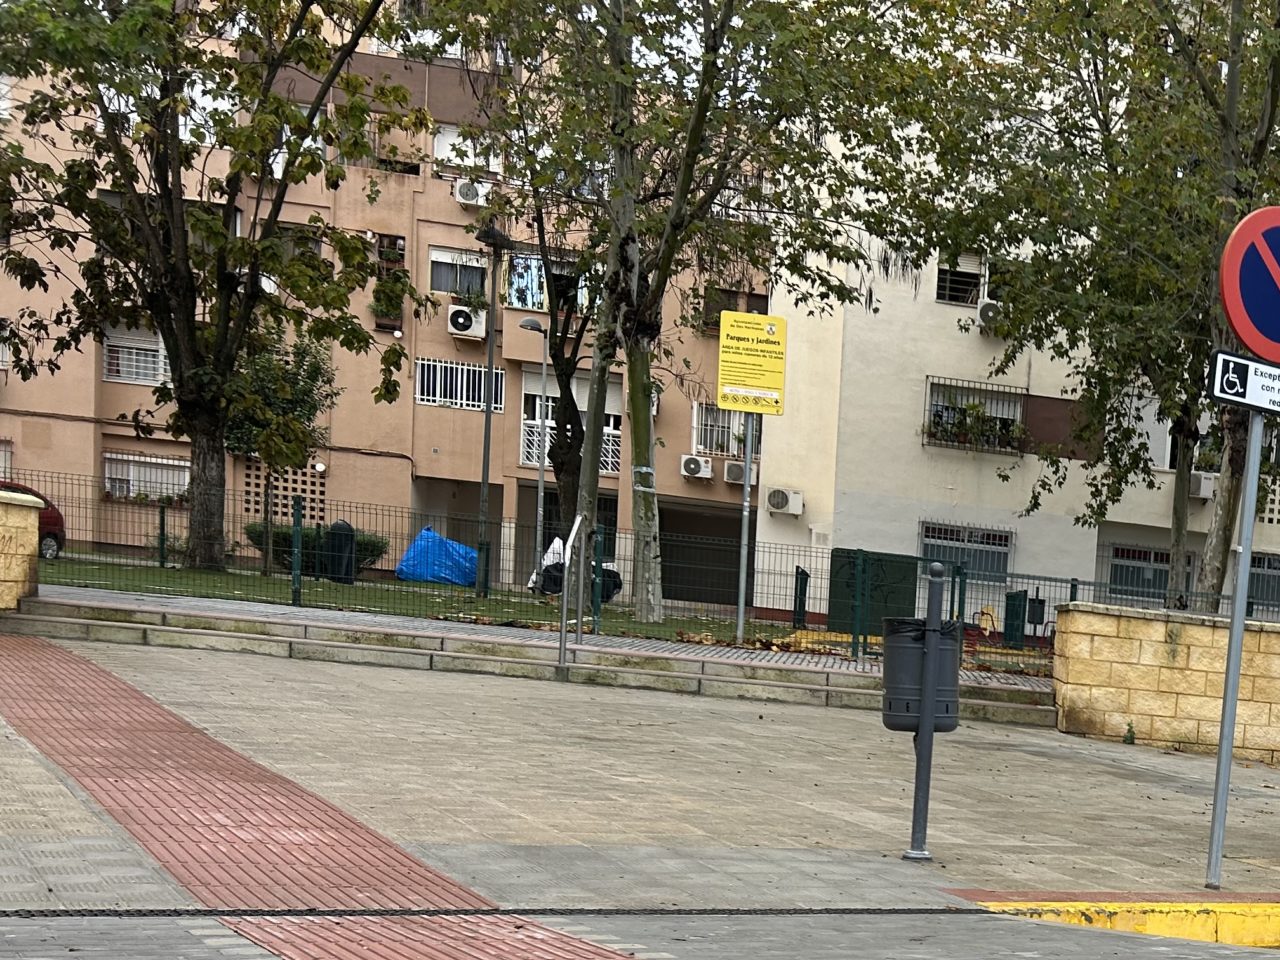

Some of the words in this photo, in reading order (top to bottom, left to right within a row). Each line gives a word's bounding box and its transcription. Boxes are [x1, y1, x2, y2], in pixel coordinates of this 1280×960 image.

[726, 333, 750, 342] Parques
[756, 337, 781, 346] Jardines
[1261, 383, 1275, 393] con
